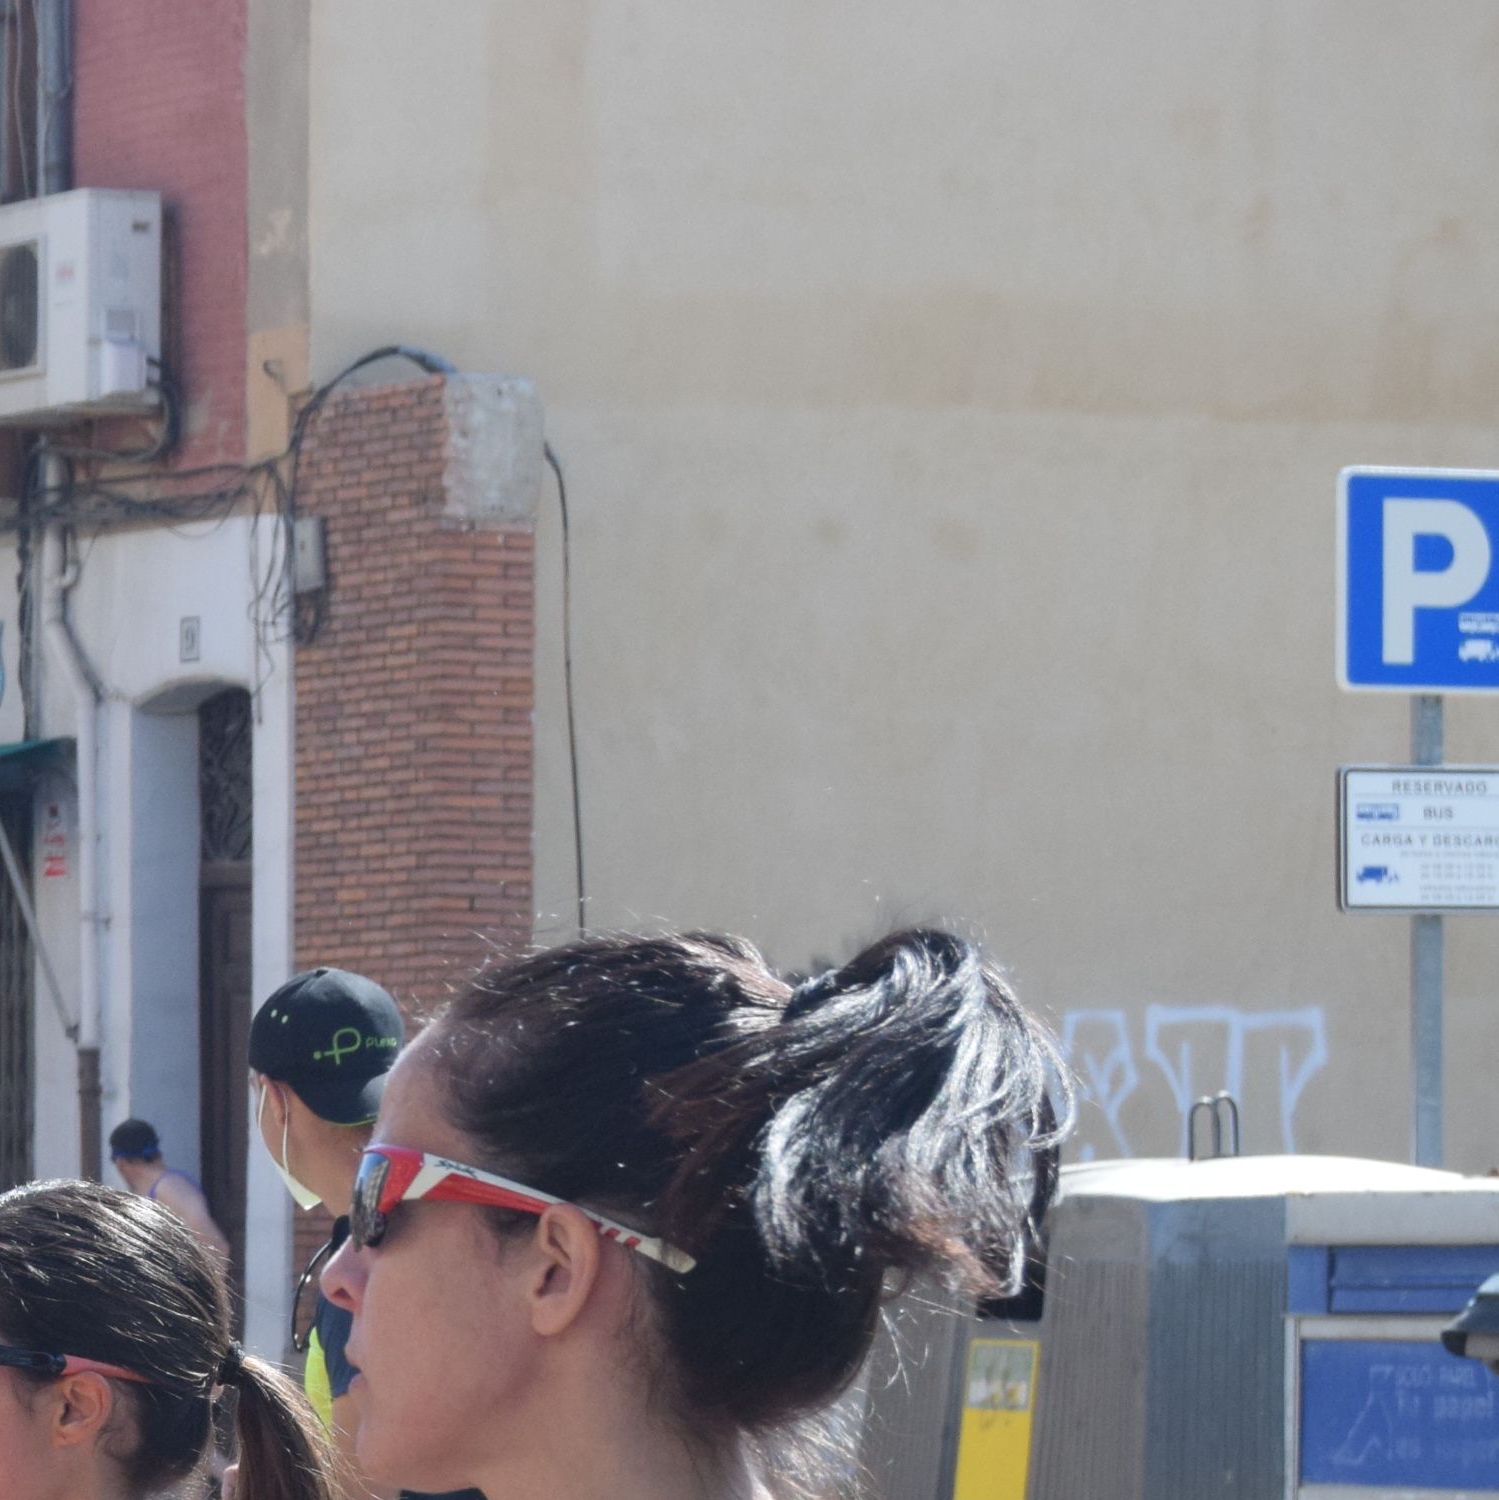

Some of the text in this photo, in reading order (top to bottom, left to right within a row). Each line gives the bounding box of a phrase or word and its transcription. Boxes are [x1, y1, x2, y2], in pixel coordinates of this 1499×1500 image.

[1383, 498, 1491, 664] P
[1391, 781, 1488, 795] RESERVADO
[1423, 806, 1454, 819] BUS
[1360, 834, 1413, 847] CARGA
